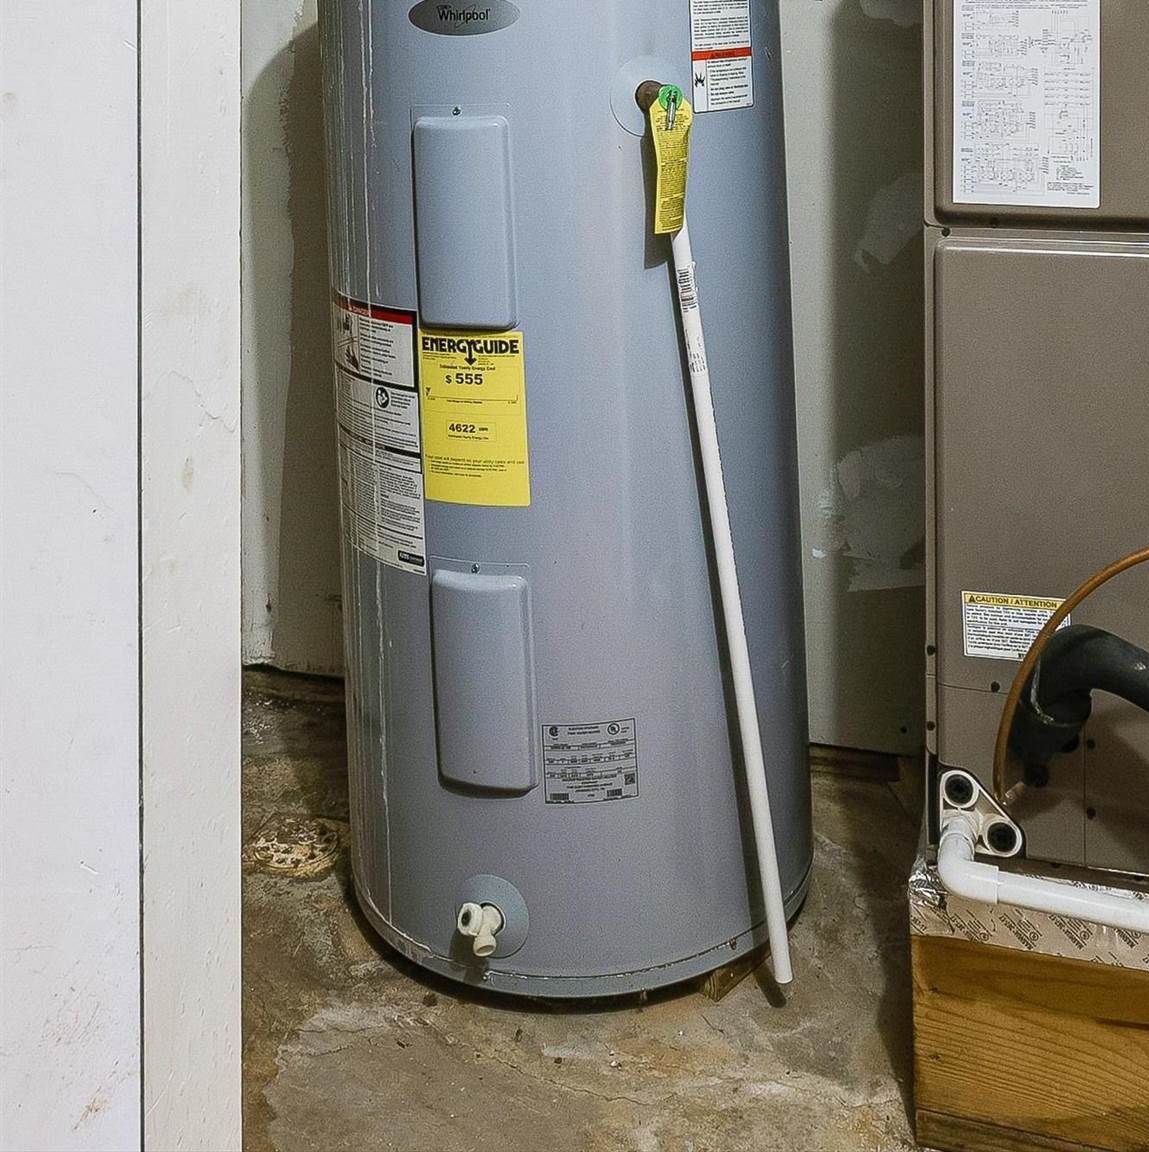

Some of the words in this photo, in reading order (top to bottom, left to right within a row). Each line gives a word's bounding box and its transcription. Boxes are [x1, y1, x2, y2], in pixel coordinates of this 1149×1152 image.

[438, 8, 489, 24] Whirlpool
[445, 374, 452, 384] $
[455, 373, 483, 385] 555
[448, 423, 476, 434] 4622
[976, 596, 1008, 605] CAUTION
[1014, 599, 1057, 609] ATTENTION
